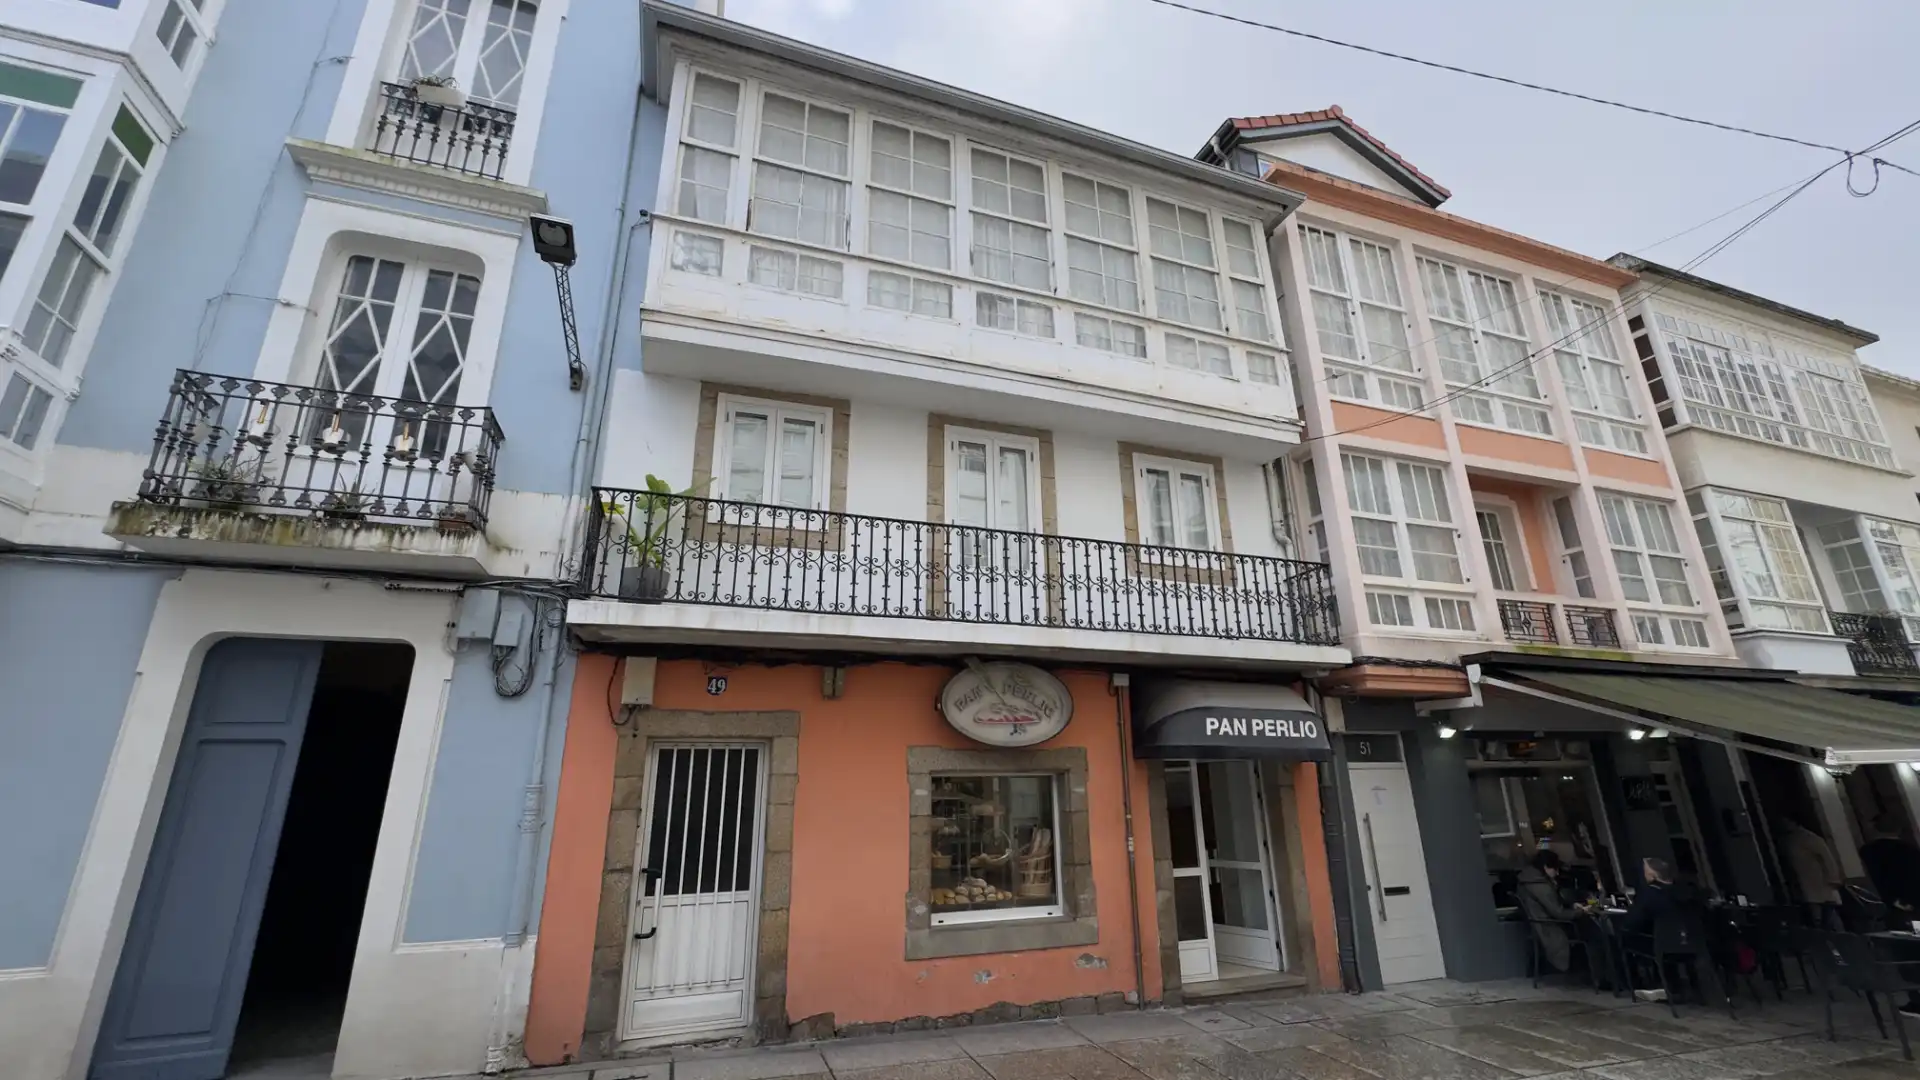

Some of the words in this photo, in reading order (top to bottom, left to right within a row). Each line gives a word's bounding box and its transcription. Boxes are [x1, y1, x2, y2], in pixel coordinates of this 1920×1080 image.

[708, 679, 726, 694] 49
[953, 684, 983, 712] PAN
[1206, 717, 1248, 736] PAN
[1251, 718, 1317, 739] PERLIO
[1360, 741, 1371, 756] 51
